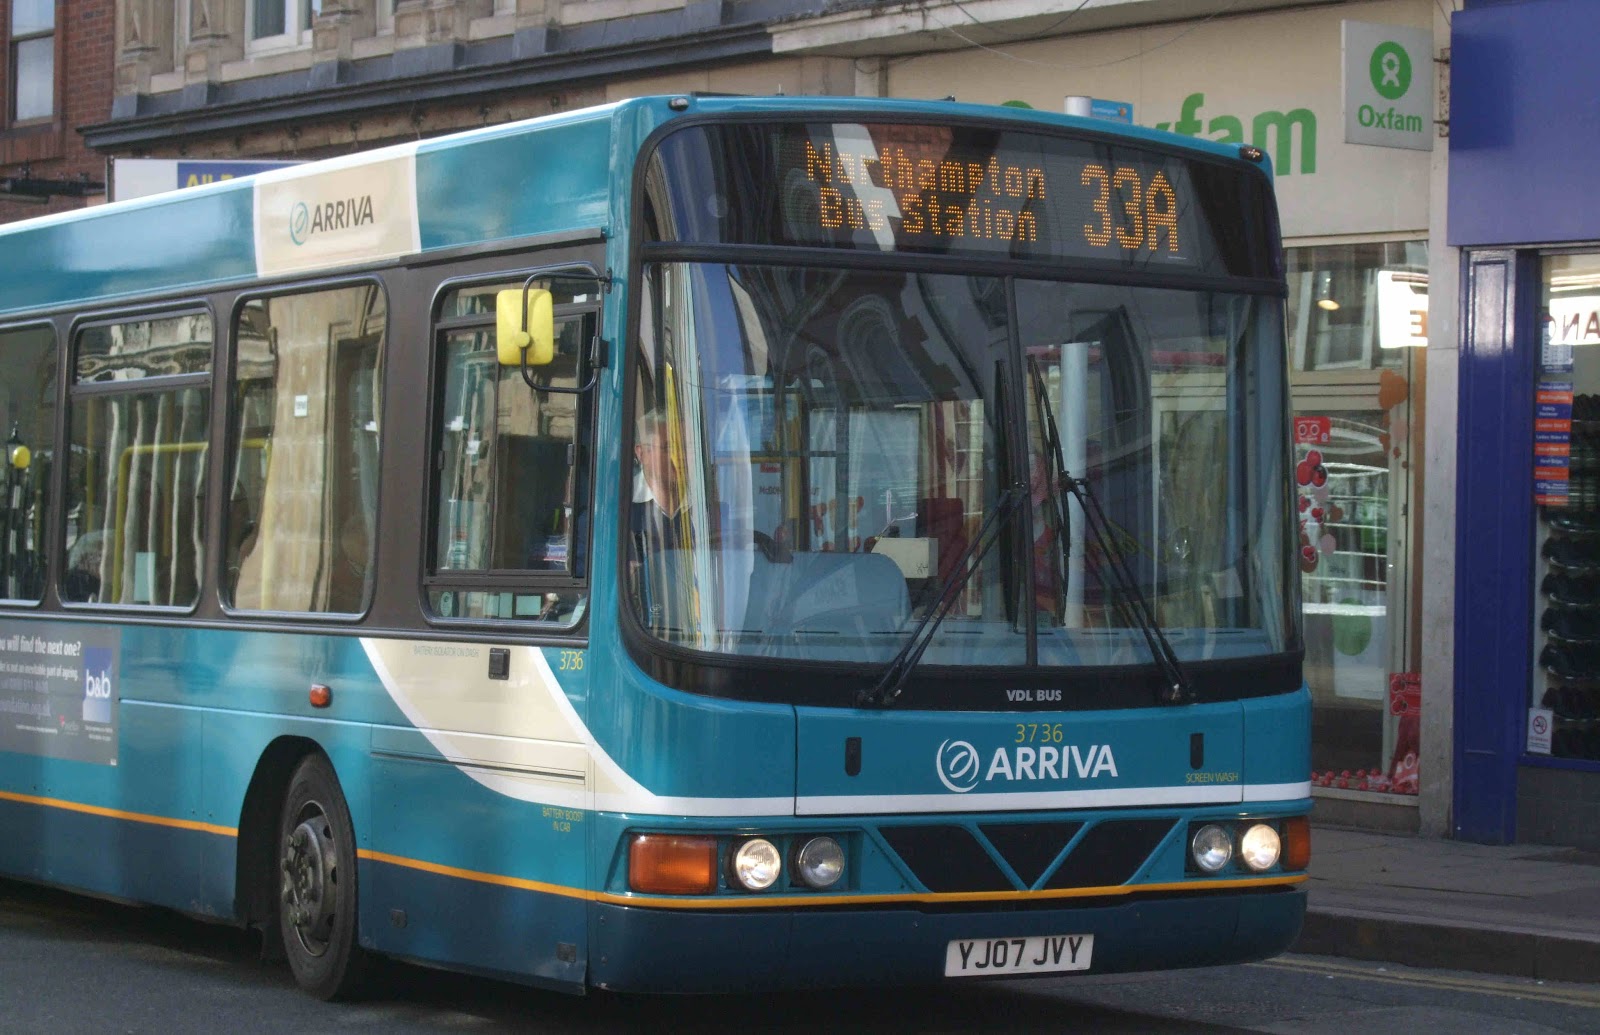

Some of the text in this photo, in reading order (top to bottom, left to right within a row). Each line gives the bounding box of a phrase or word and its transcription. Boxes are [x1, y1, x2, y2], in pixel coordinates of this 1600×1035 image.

[1358, 104, 1423, 132] Oxfam
[806, 141, 1179, 252] Northampton 33A
[311, 195, 374, 234] ARRIVA
[820, 187, 1037, 242] Bus Station
[7, 634, 19, 652] will
[20, 635, 34, 653] find
[35, 636, 46, 654] the
[47, 640, 63, 655] next
[63, 641, 81, 656] one?
[559, 650, 584, 670] 3736
[86, 669, 111, 698] b&b
[1006, 689, 1062, 702] VDL BUS
[1015, 723, 1063, 743] 3736
[985, 744, 1118, 781] ARRIVA
[1186, 772, 1239, 783] SCREEN WASH
[542, 807, 564, 819] BATTERY
[959, 936, 1083, 970] YJ07 JVY
